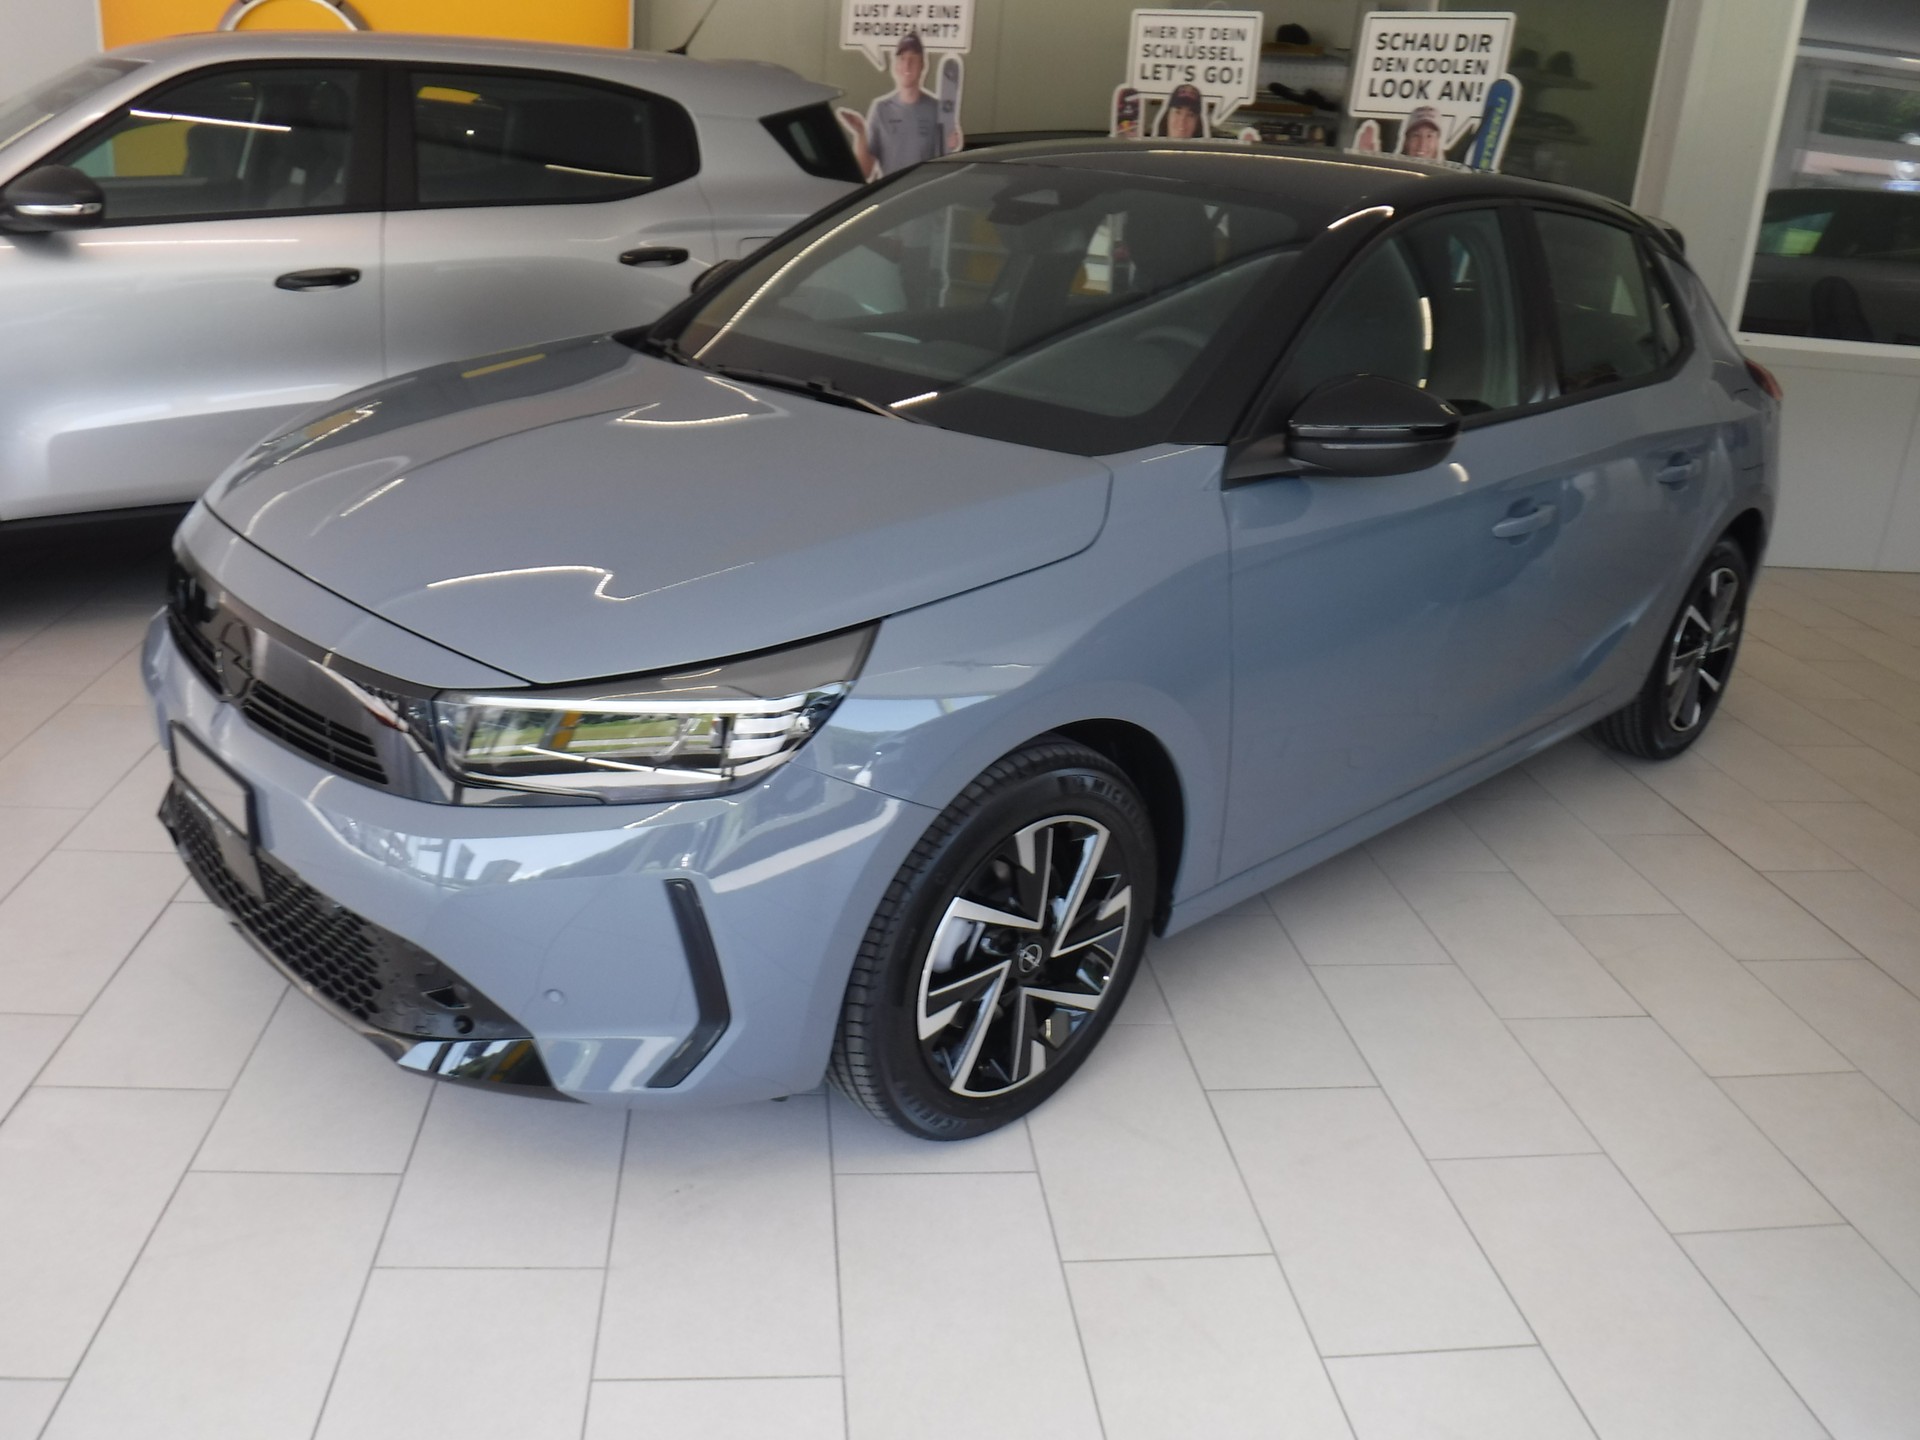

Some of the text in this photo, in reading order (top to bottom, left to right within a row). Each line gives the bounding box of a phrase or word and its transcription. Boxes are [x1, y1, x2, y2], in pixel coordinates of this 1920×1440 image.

[854, 4, 961, 19] LUST AUF EINE
[853, 22, 961, 38] PROBEFAHRT?
[1143, 26, 1247, 41] HIER IST DEIN
[1142, 41, 1244, 62] SCHLÜSSEL.
[1375, 32, 1493, 53] SCHAU DIR
[1140, 63, 1244, 85] LET'S GO!
[1372, 56, 1488, 75] DEN COOLEN
[1368, 78, 1484, 102] LOOK AN!
